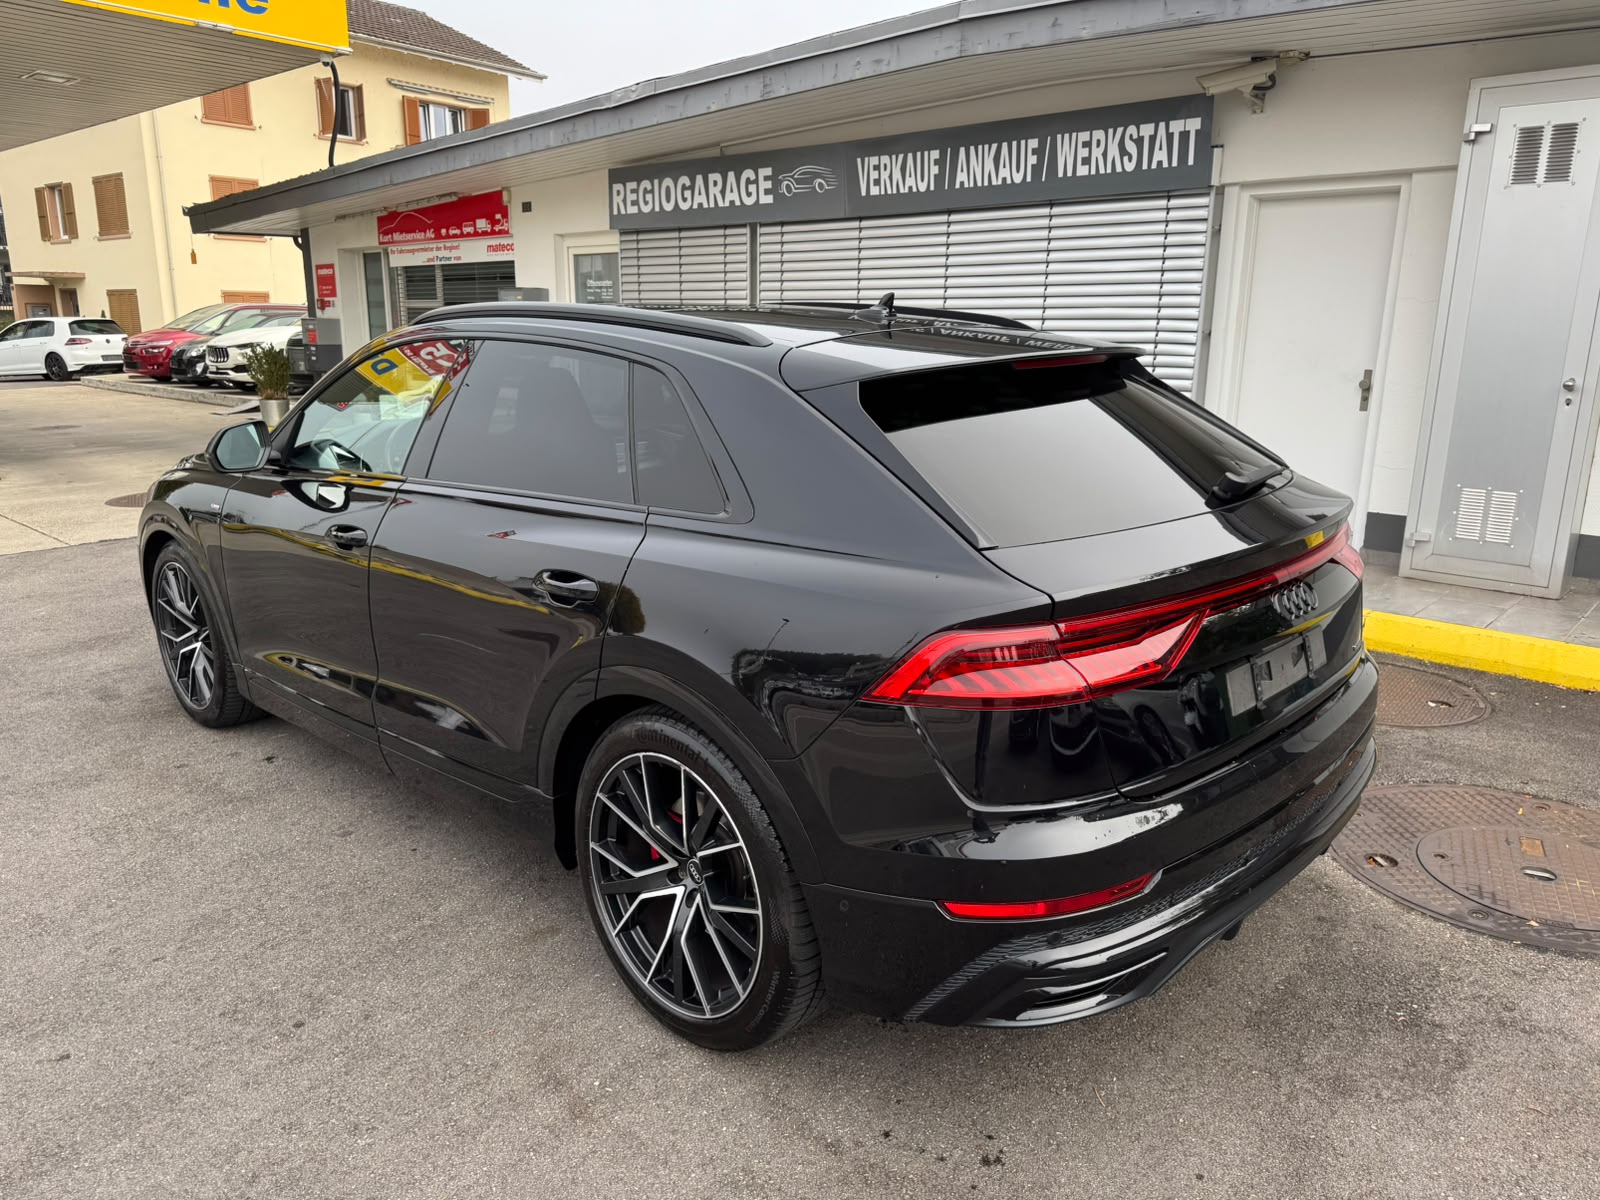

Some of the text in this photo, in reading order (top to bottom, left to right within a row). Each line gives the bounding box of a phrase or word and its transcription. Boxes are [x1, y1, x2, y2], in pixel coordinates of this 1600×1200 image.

[856, 149, 940, 196] VERKAUF
[955, 138, 1039, 189] ANKAUF
[1056, 117, 1202, 178] WERKSTATT
[612, 167, 774, 215] REGIOGARAGE
[393, 229, 425, 241] Mietservice
[426, 228, 435, 238] AG
